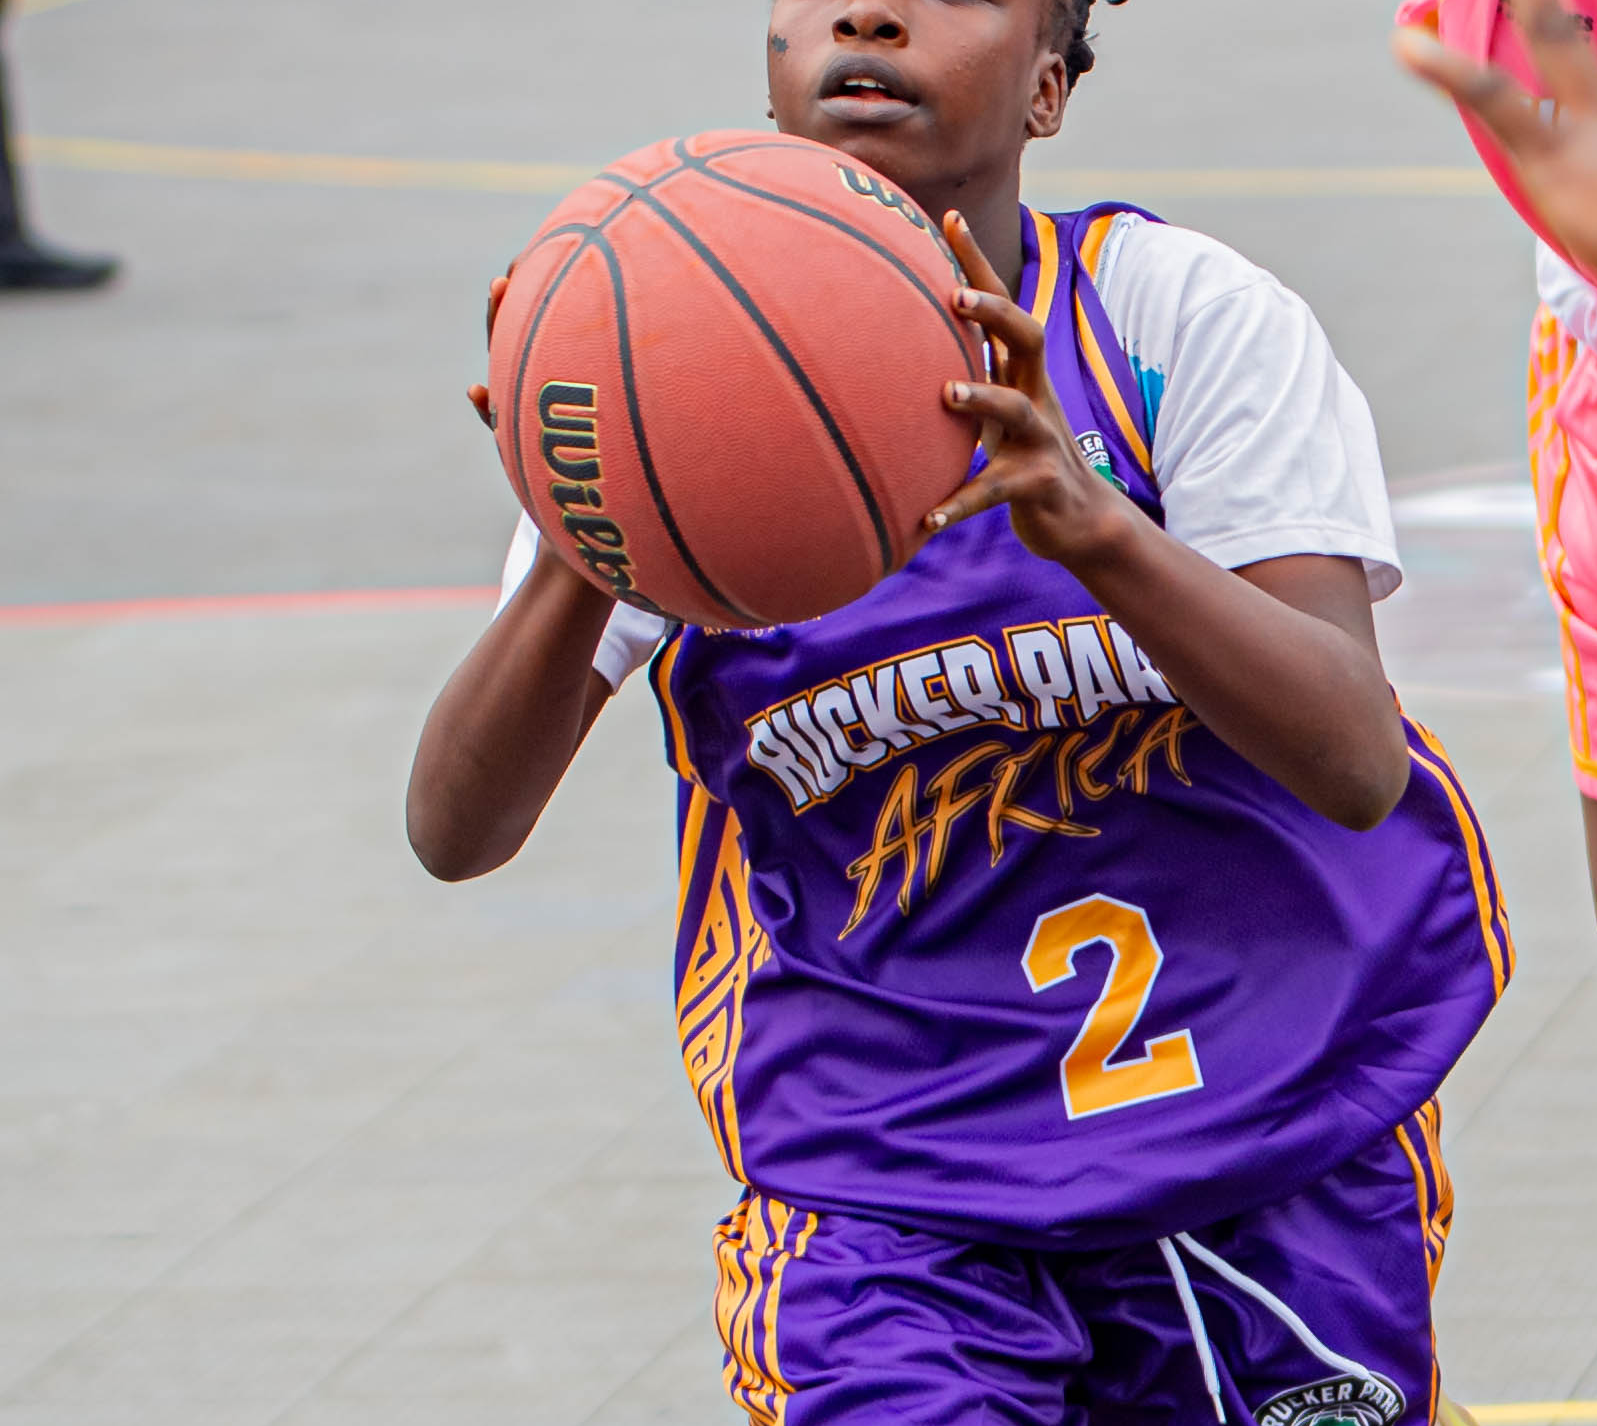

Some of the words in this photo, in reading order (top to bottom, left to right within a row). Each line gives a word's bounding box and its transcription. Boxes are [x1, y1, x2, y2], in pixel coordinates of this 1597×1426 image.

[745, 635, 1025, 816] RUCKER
[838, 706, 1200, 941] AFRICA
[1021, 893, 1204, 1120] 2
[1359, 1381, 1401, 1422] PARK
